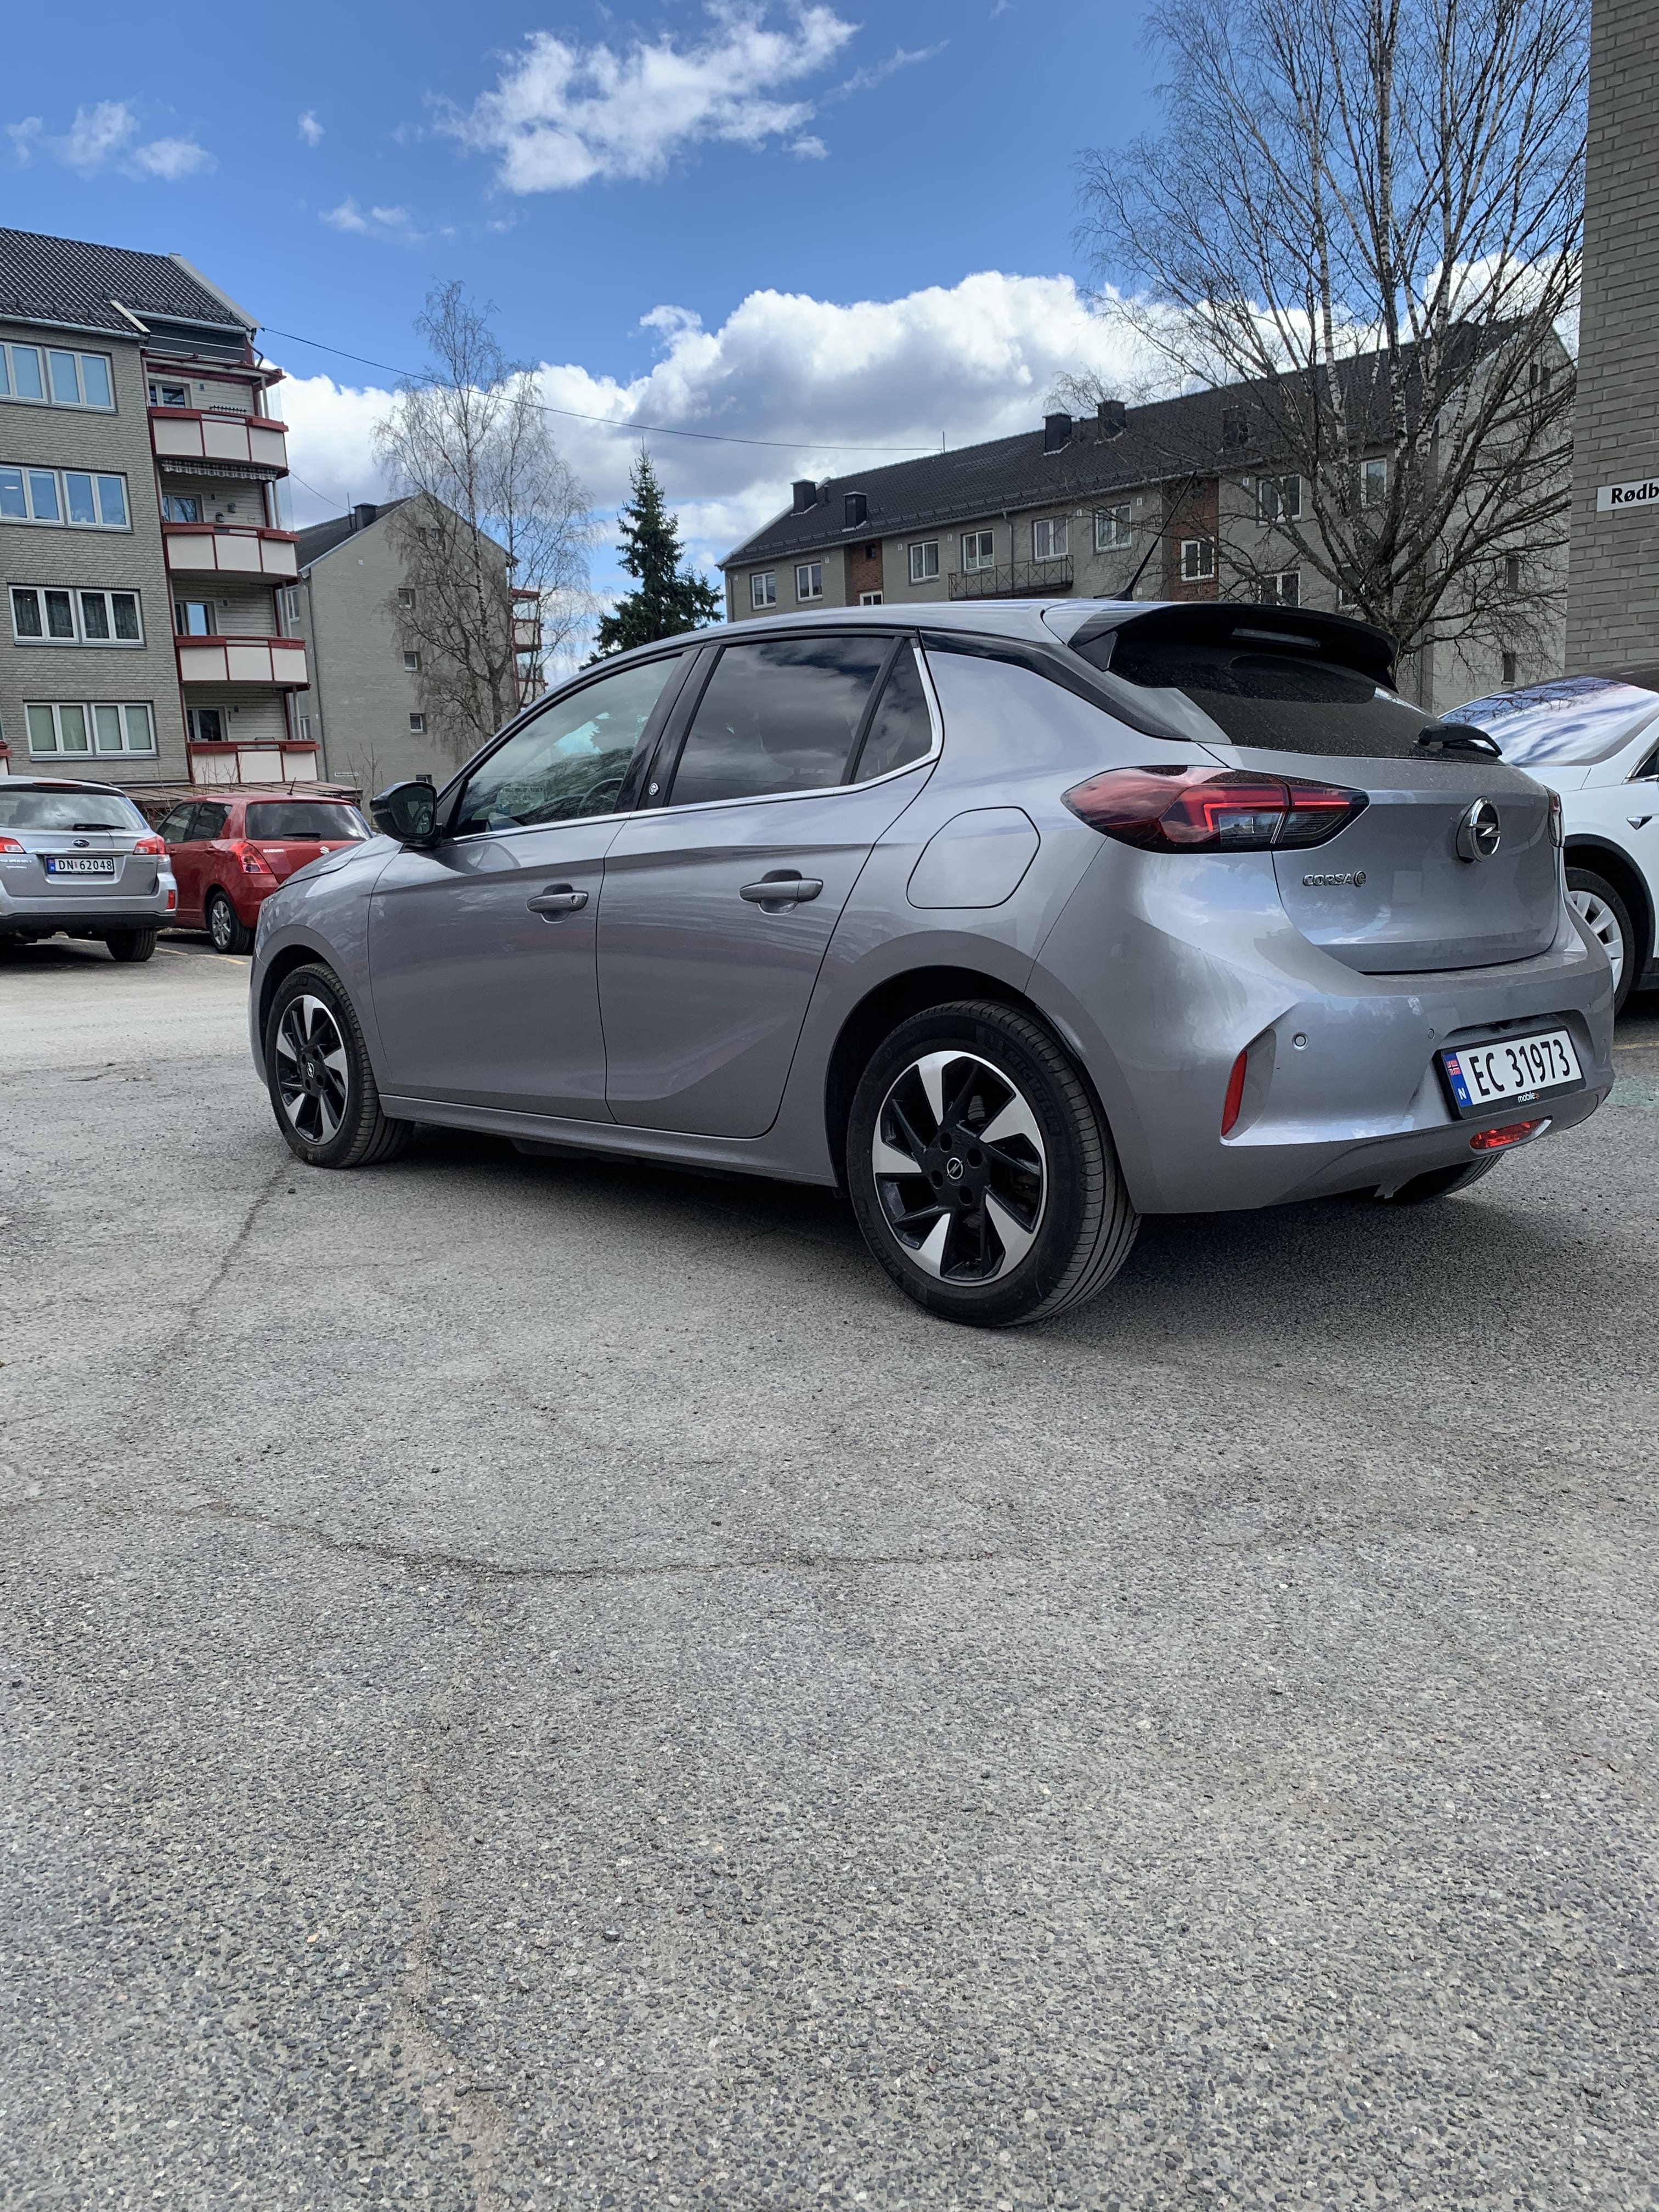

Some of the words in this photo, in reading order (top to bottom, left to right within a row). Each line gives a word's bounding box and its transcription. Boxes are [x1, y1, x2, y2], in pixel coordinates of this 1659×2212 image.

[1611, 482, 1659, 504] Rødb
[58, 860, 74, 870] DN
[80, 860, 112, 870] 62048
[1469, 1052, 1505, 1097] EC
[1505, 1039, 1570, 1088] 31973
[1458, 1087, 1467, 1100] N
